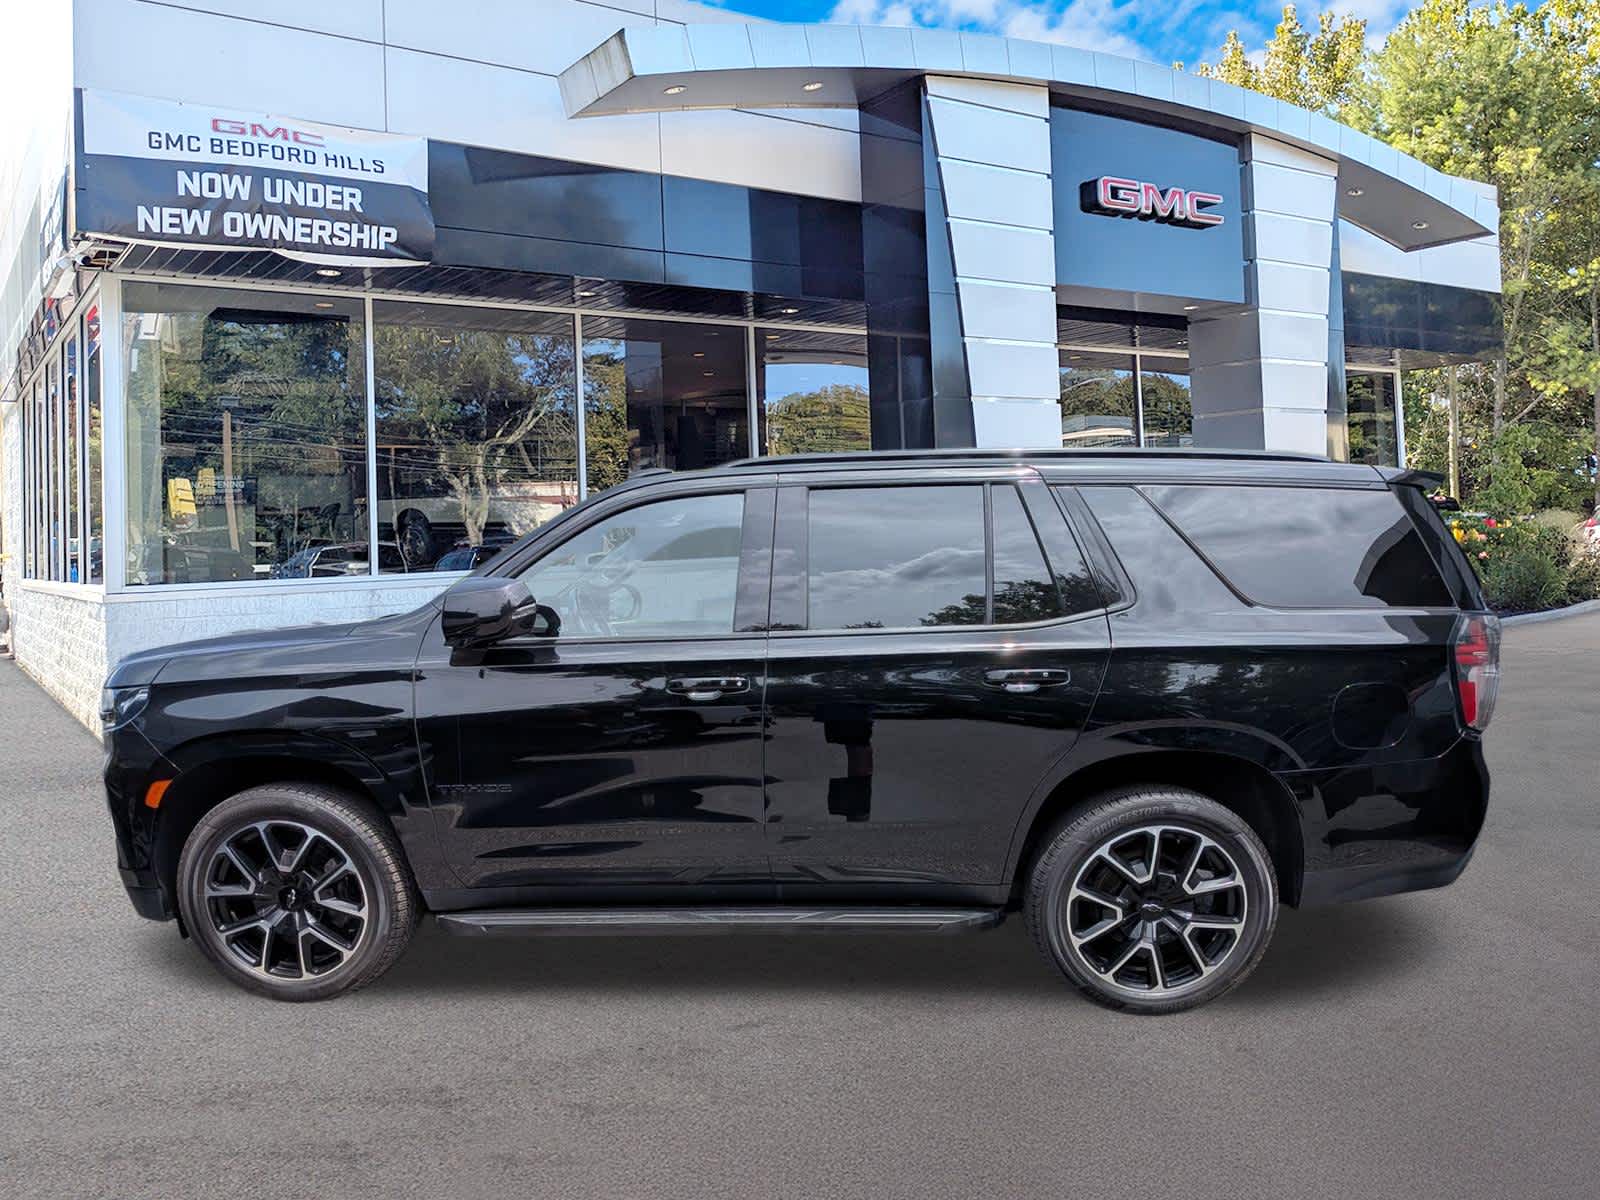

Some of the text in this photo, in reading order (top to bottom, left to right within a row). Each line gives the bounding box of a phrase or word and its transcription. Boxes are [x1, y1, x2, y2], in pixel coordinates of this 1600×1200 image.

[148, 131, 385, 174] GMC BEDFORD HILLS
[211, 118, 325, 148] GMC
[177, 170, 364, 213] NOW UNDER
[1096, 175, 1225, 225] GMC
[136, 205, 398, 251] NEW OWNERSHIP
